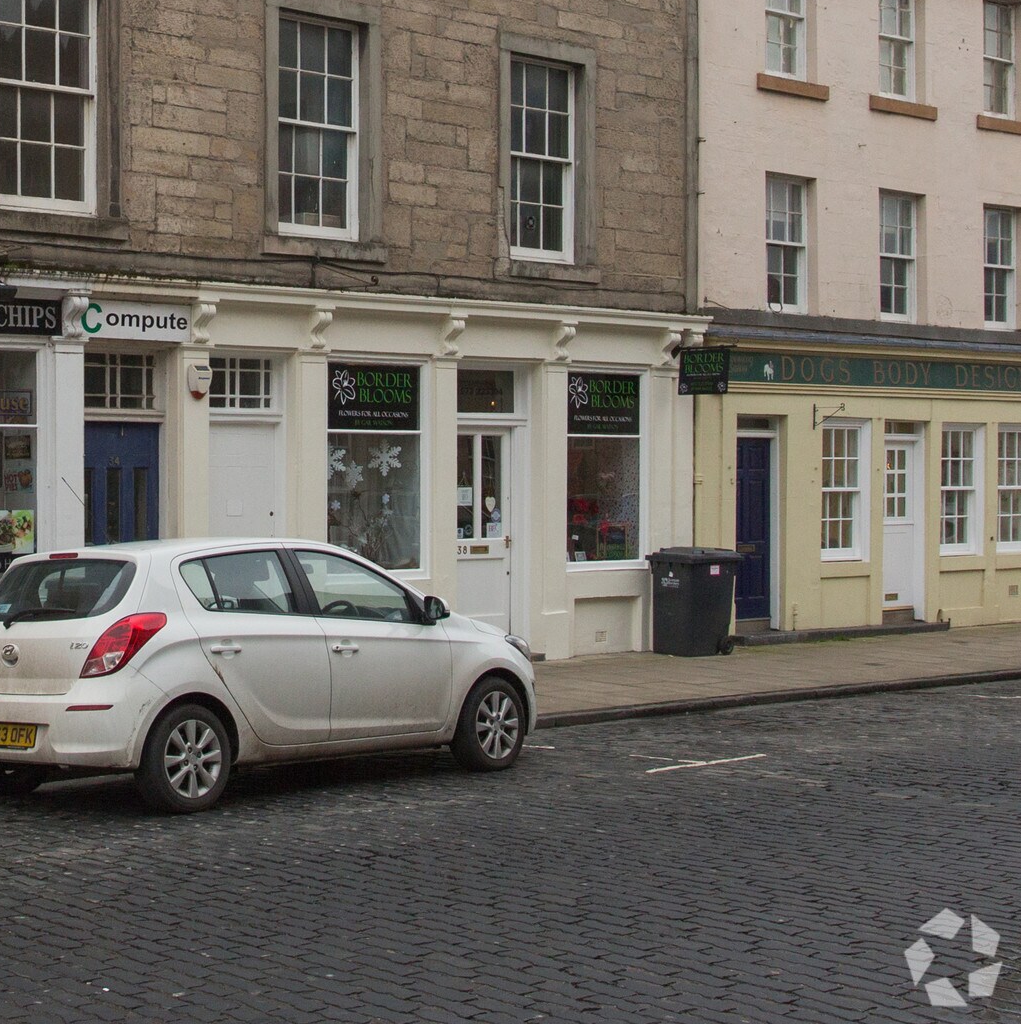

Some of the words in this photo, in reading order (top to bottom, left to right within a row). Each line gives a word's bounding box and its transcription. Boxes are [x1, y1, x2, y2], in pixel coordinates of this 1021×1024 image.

[81, 302, 188, 334] Compute
[683, 352, 725, 364] BORDER
[684, 362, 724, 374] BLOOMS
[781, 355, 851, 383] DOGS
[873, 360, 931, 385] BODY
[955, 364, 1021, 388] DESIG
[357, 371, 413, 388] BORDER
[589, 379, 636, 395] BORDER
[359, 388, 412, 404] BLOOMS
[591, 394, 635, 409] BLOOMS
[338, 409, 361, 417] FLOWERS
[456, 545, 468, 555] 38
[10, 727, 34, 744] OFK
